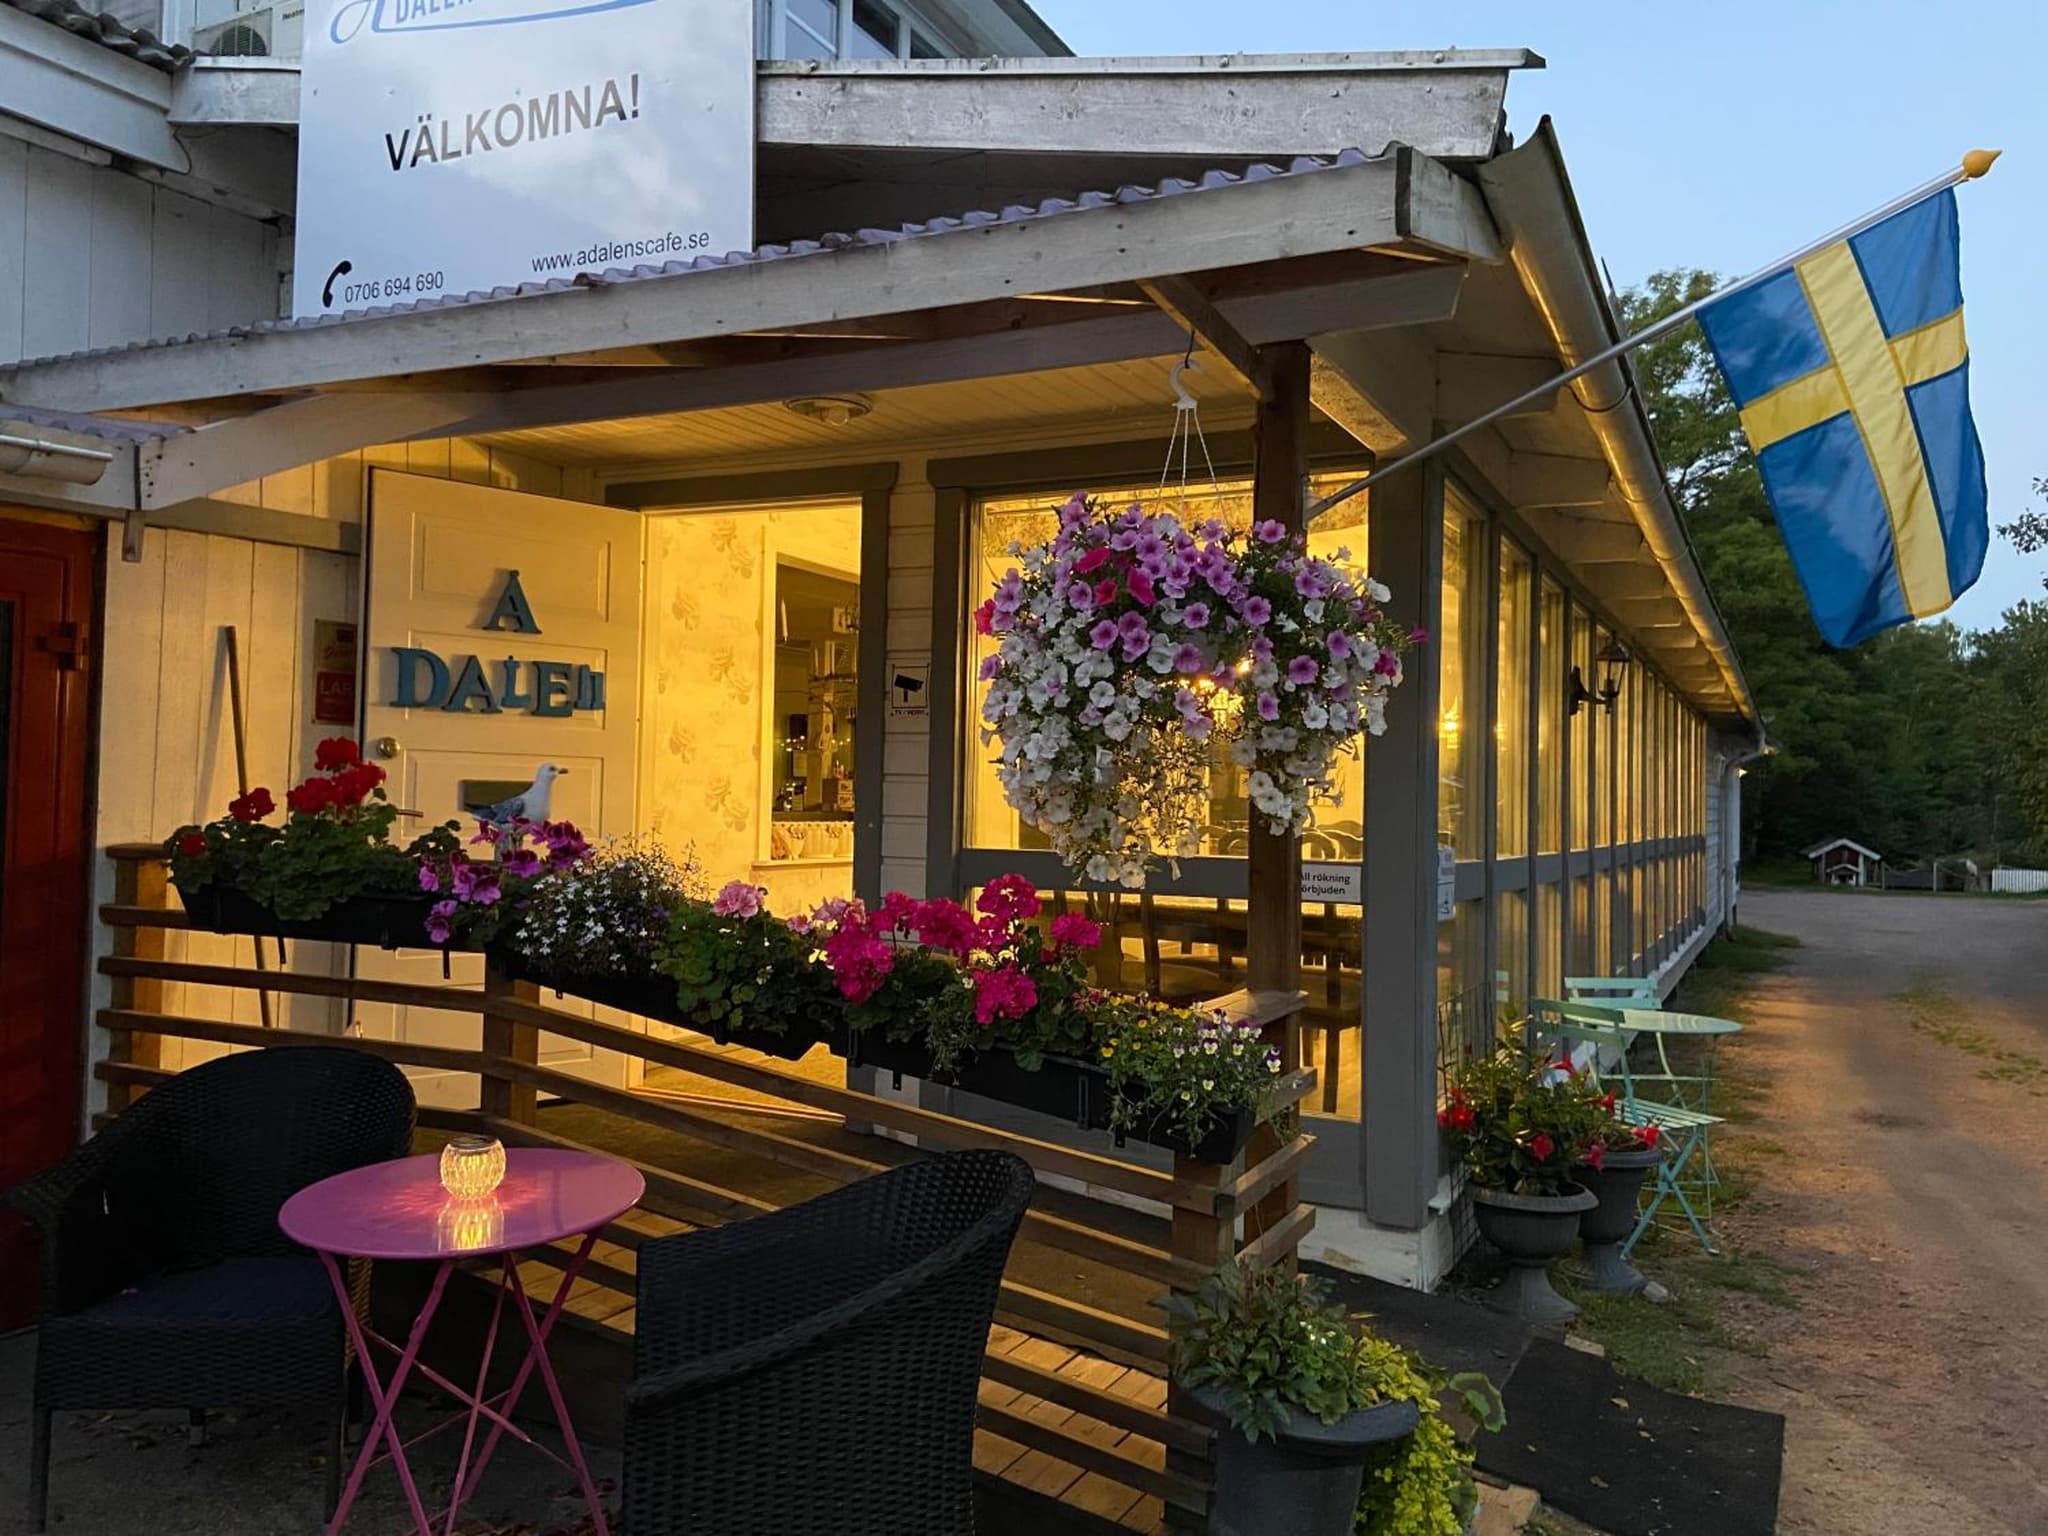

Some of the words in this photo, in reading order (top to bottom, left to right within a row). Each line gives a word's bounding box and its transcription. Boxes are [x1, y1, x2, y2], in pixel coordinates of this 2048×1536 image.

[385, 74, 639, 171] VÄLKOMNA!
[531, 232, 710, 273] www.adalenscafe.se
[344, 282, 380, 303] 0706
[384, 277, 411, 297] 694
[416, 271, 444, 292] 690
[481, 569, 542, 634] A
[1300, 884, 1346, 897] örbjuden
[1313, 872, 1351, 886] rökning
